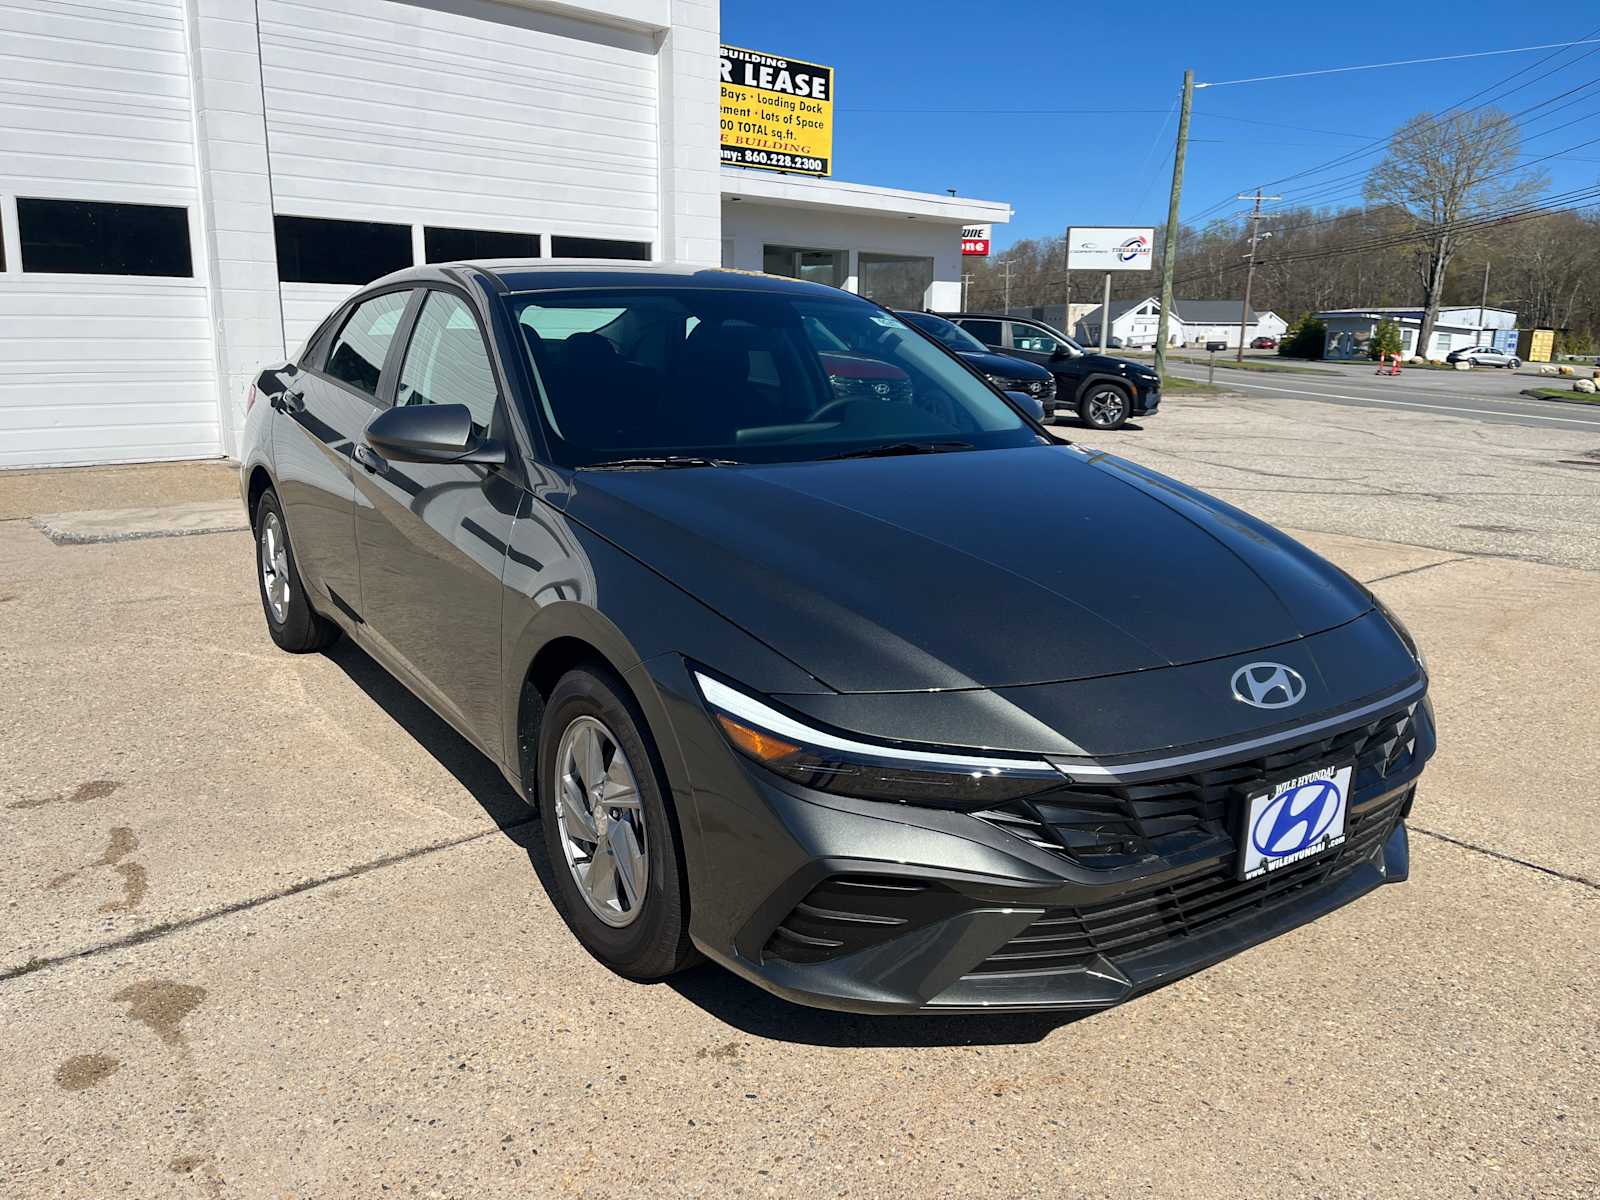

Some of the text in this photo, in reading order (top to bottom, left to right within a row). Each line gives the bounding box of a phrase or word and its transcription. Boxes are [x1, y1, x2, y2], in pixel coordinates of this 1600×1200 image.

[720, 48, 787, 68] BUILDING
[745, 62, 826, 99] LEASE
[721, 87, 823, 114] Bays Loading Dock
[738, 121, 768, 136] TOTAL
[761, 109, 780, 122] Lots
[783, 115, 793, 124] of
[796, 116, 824, 130] Space
[735, 136, 812, 154] BUILDING
[744, 150, 823, 171] 860.228.2300
[1275, 766, 1335, 794] WILE HYUNDAI
